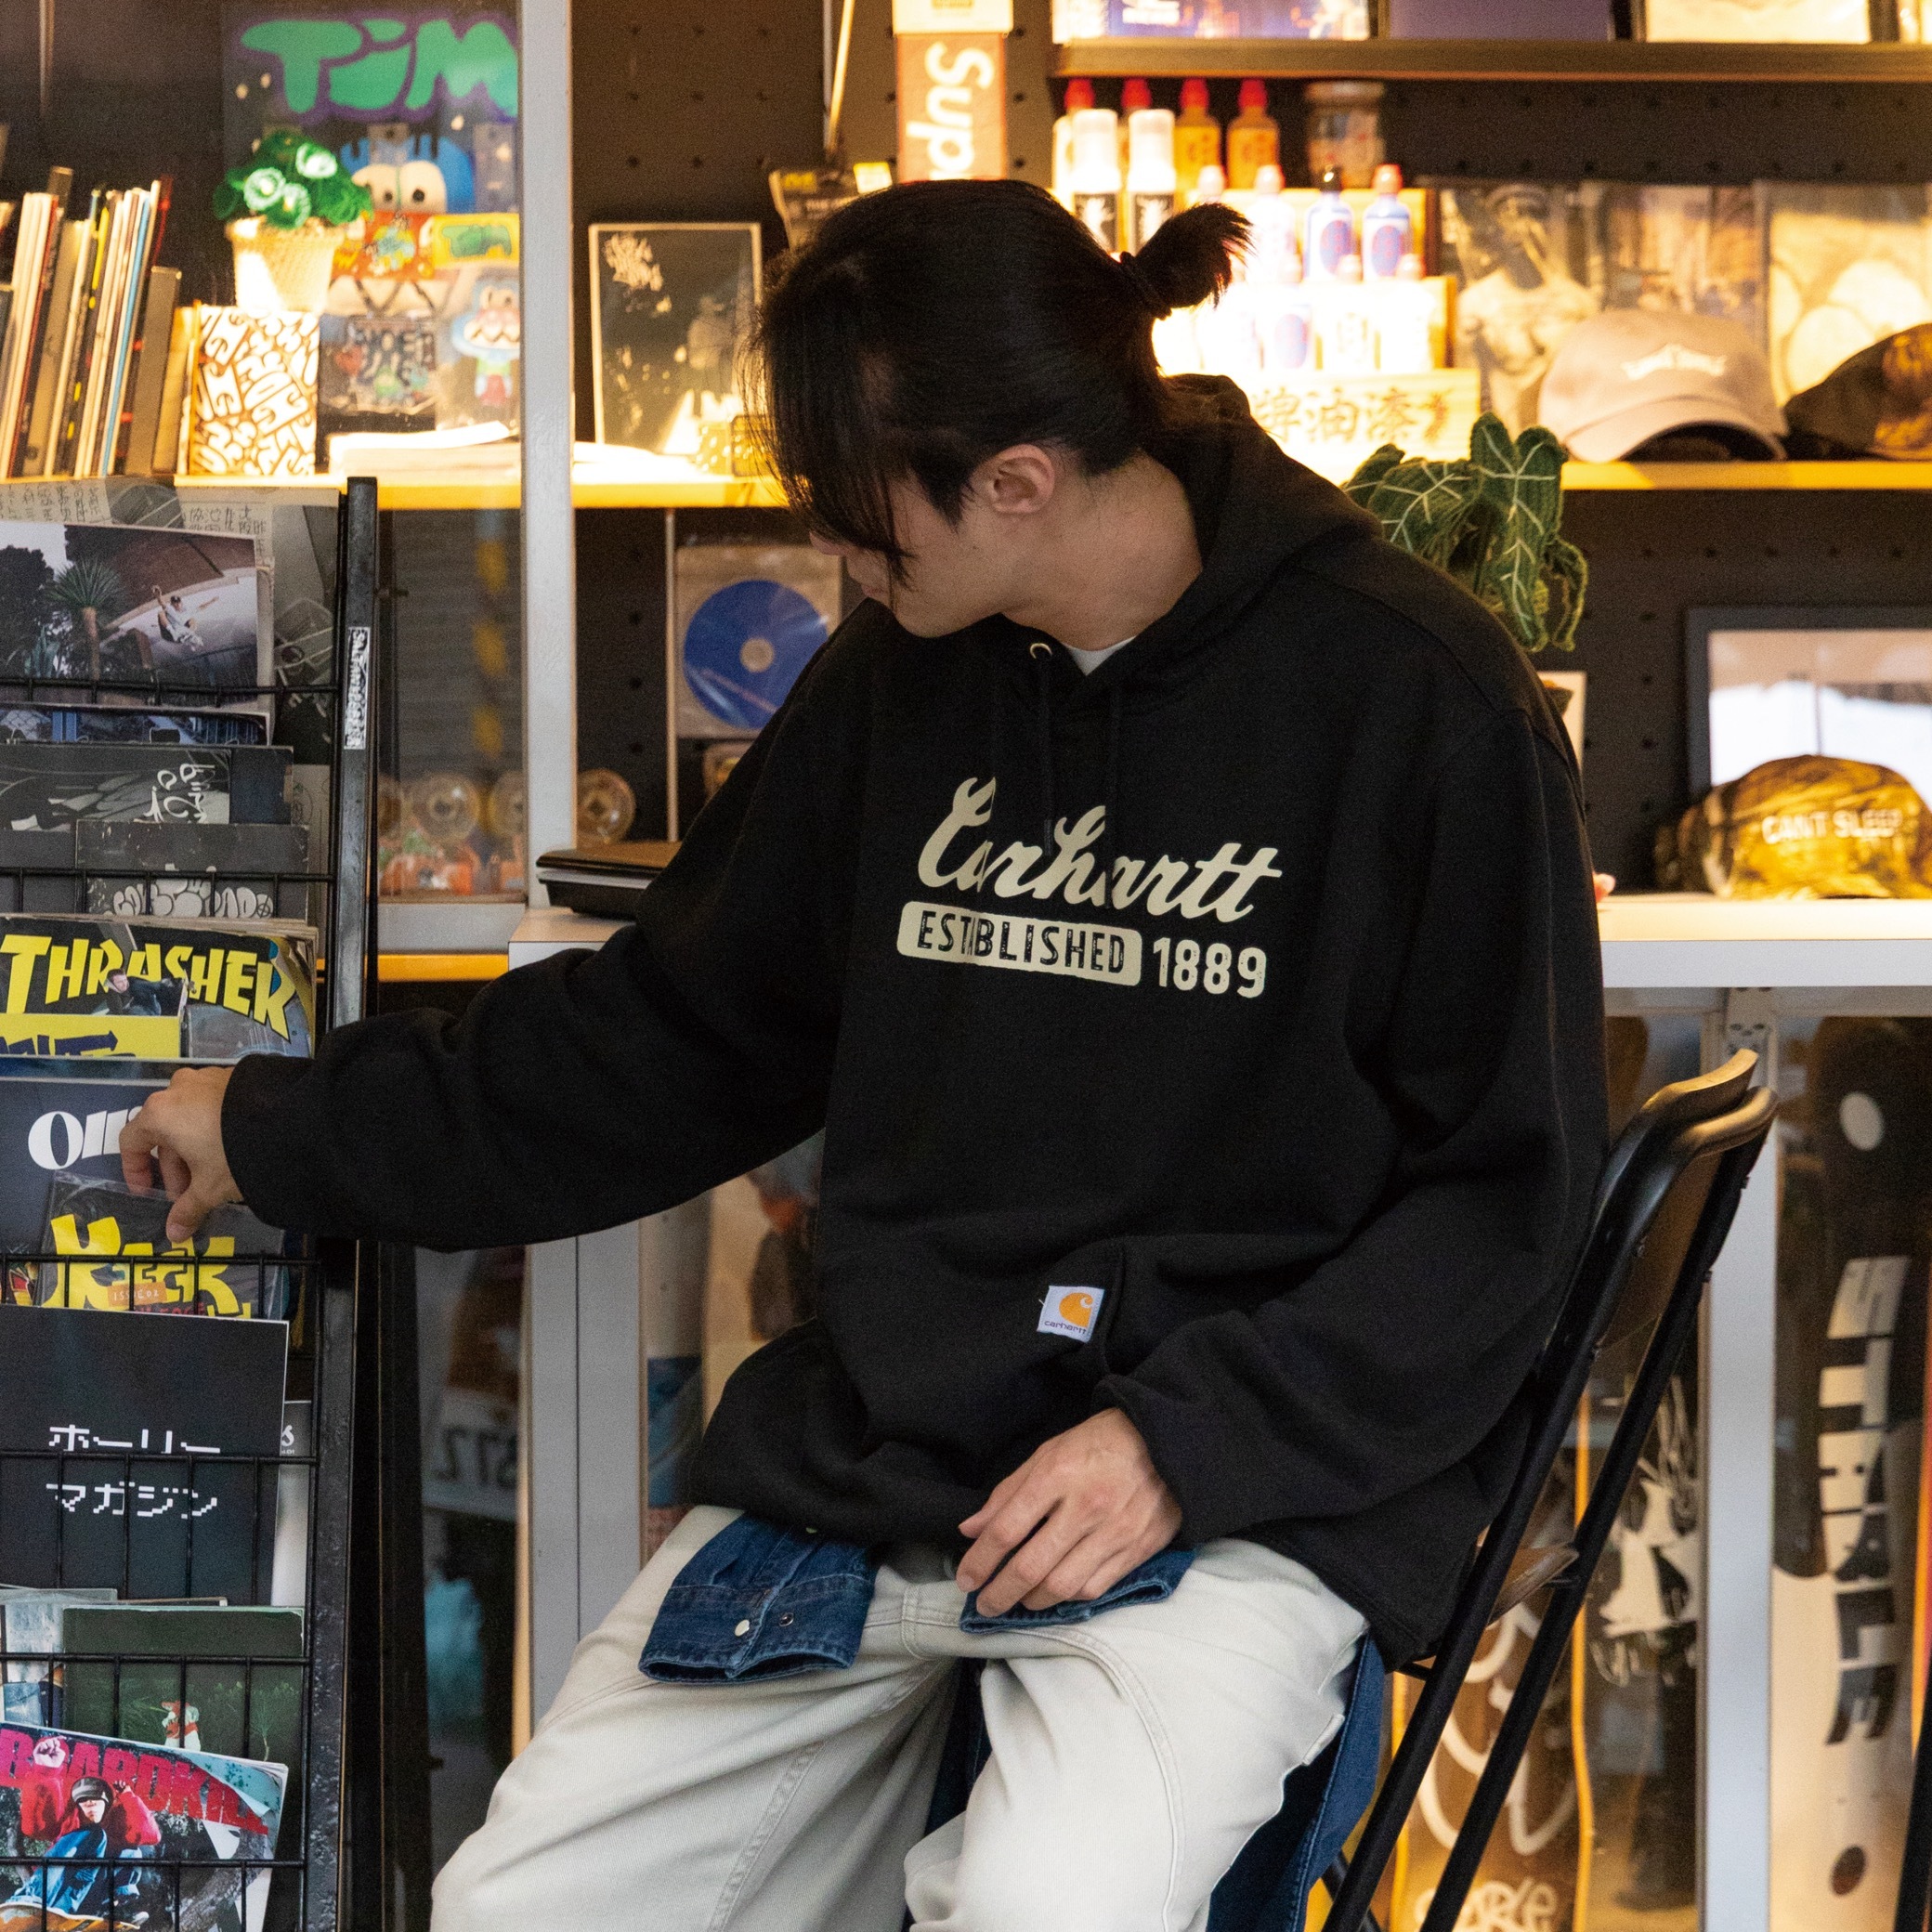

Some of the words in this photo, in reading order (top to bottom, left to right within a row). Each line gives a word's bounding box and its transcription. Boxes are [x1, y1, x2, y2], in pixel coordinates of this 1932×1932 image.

[906, 41, 995, 180] Sup
[917, 909, 1126, 974] ESTBLISHED
[1153, 937, 1267, 999] 1889
[0, 933, 296, 1044] THRASHER
[1044, 1319, 1087, 1335] carhartt
[49, 1424, 221, 1455] ホーリー
[46, 1481, 217, 1520] マガジン
